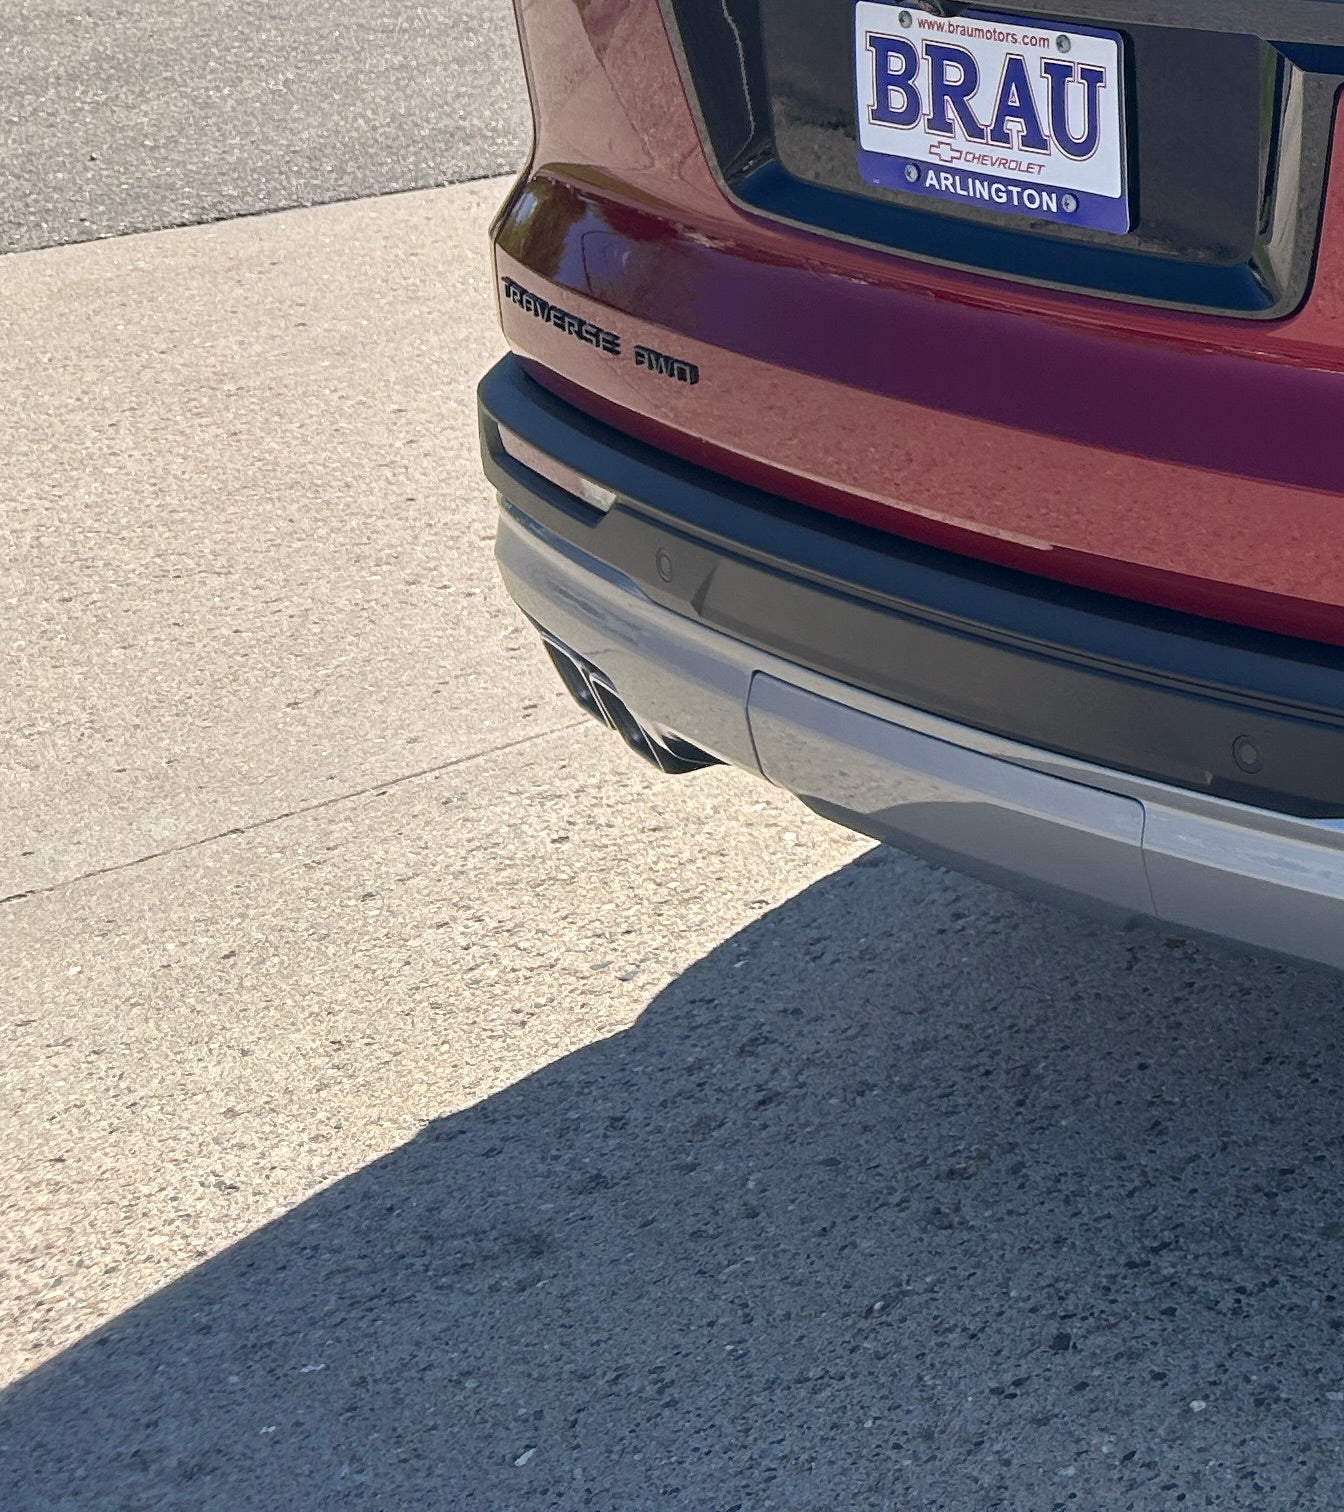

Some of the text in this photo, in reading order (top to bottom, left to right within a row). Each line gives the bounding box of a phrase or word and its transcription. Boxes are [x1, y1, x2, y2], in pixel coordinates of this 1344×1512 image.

[917, 16, 1050, 49] www.braumotors.com
[864, 30, 1107, 162] BRAU
[963, 150, 1046, 176] CHEVROLET
[925, 169, 1058, 213] ARLINGTON
[500, 275, 622, 356] TRAVERSE
